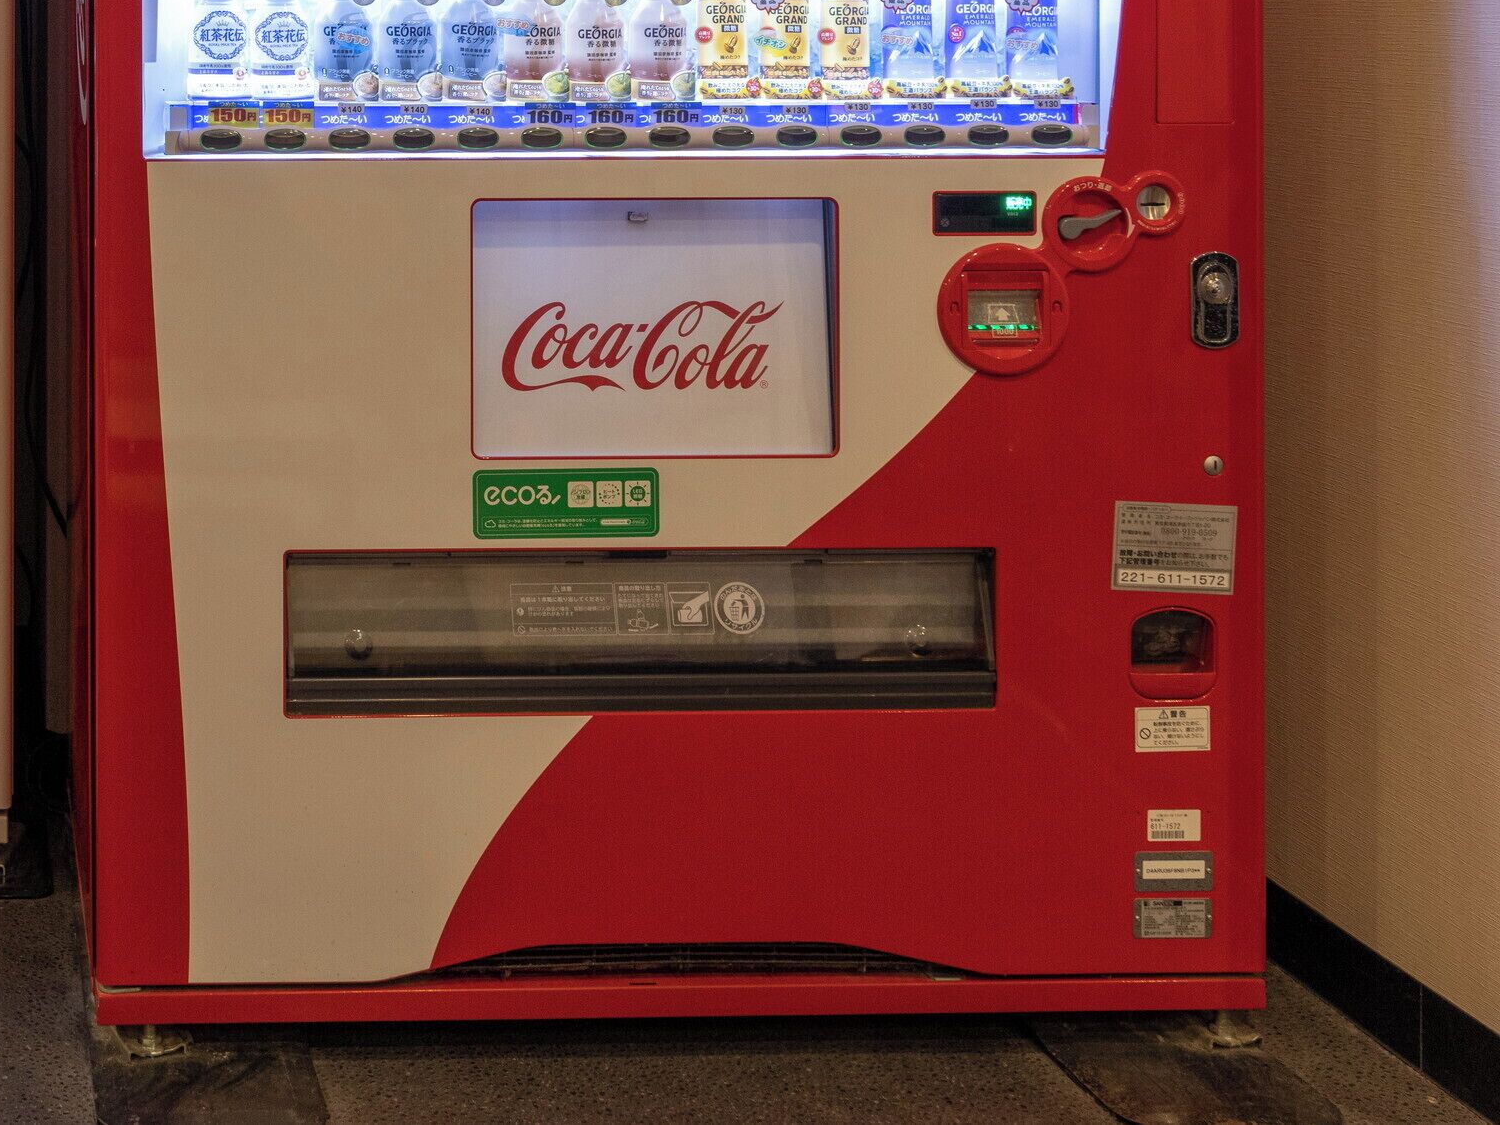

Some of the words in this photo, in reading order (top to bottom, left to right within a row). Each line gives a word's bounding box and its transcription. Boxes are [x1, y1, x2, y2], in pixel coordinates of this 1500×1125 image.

[712, 15, 744, 23] GRAND
[776, 15, 807, 24] GRAND
[200, 29, 244, 42] 紅茶花伝
[261, 29, 305, 43] 紅茶花伝
[386, 24, 432, 37] GEORGIA
[578, 25, 622, 40] GEORGIA
[211, 108, 256, 122] 150円
[266, 108, 311, 122] 150円
[527, 110, 572, 123] 160円
[654, 110, 698, 123] 160円
[502, 300, 784, 392] Coca-Cola
